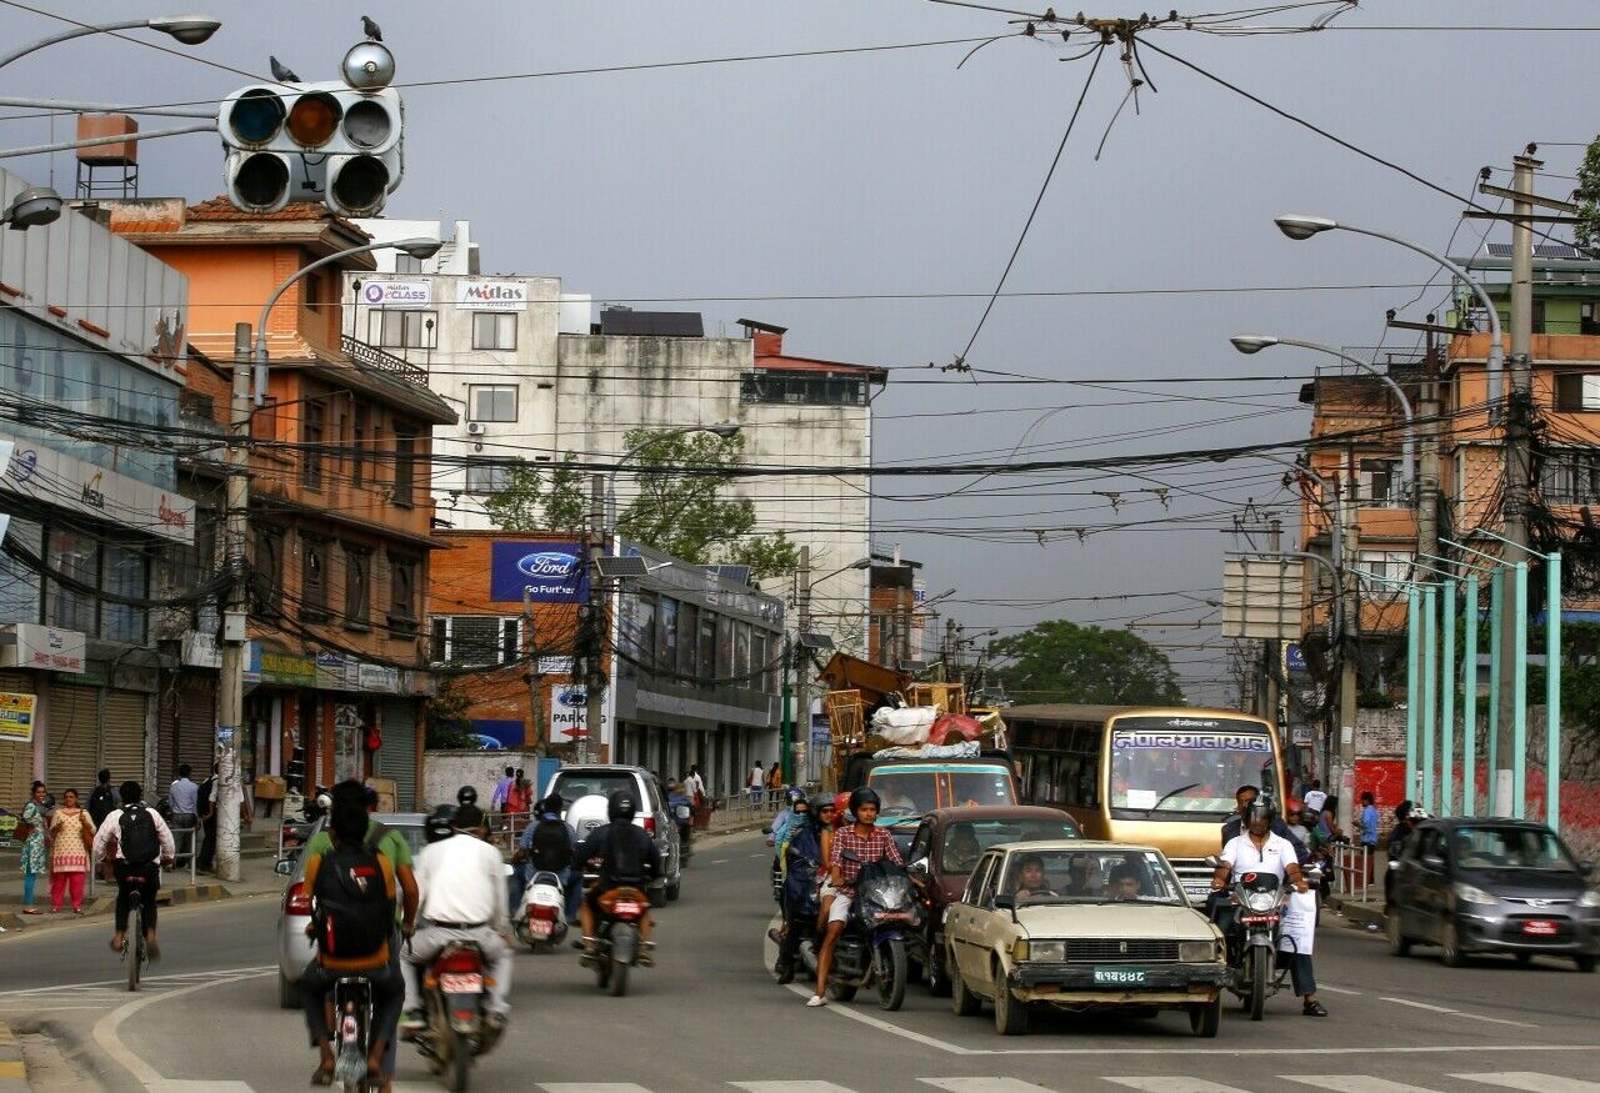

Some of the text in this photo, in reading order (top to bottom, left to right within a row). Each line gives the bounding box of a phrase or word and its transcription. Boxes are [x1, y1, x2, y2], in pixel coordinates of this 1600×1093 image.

[530, 556, 571, 575] Ford
[525, 585, 539, 594] Go
[553, 712, 607, 724] PARKG
